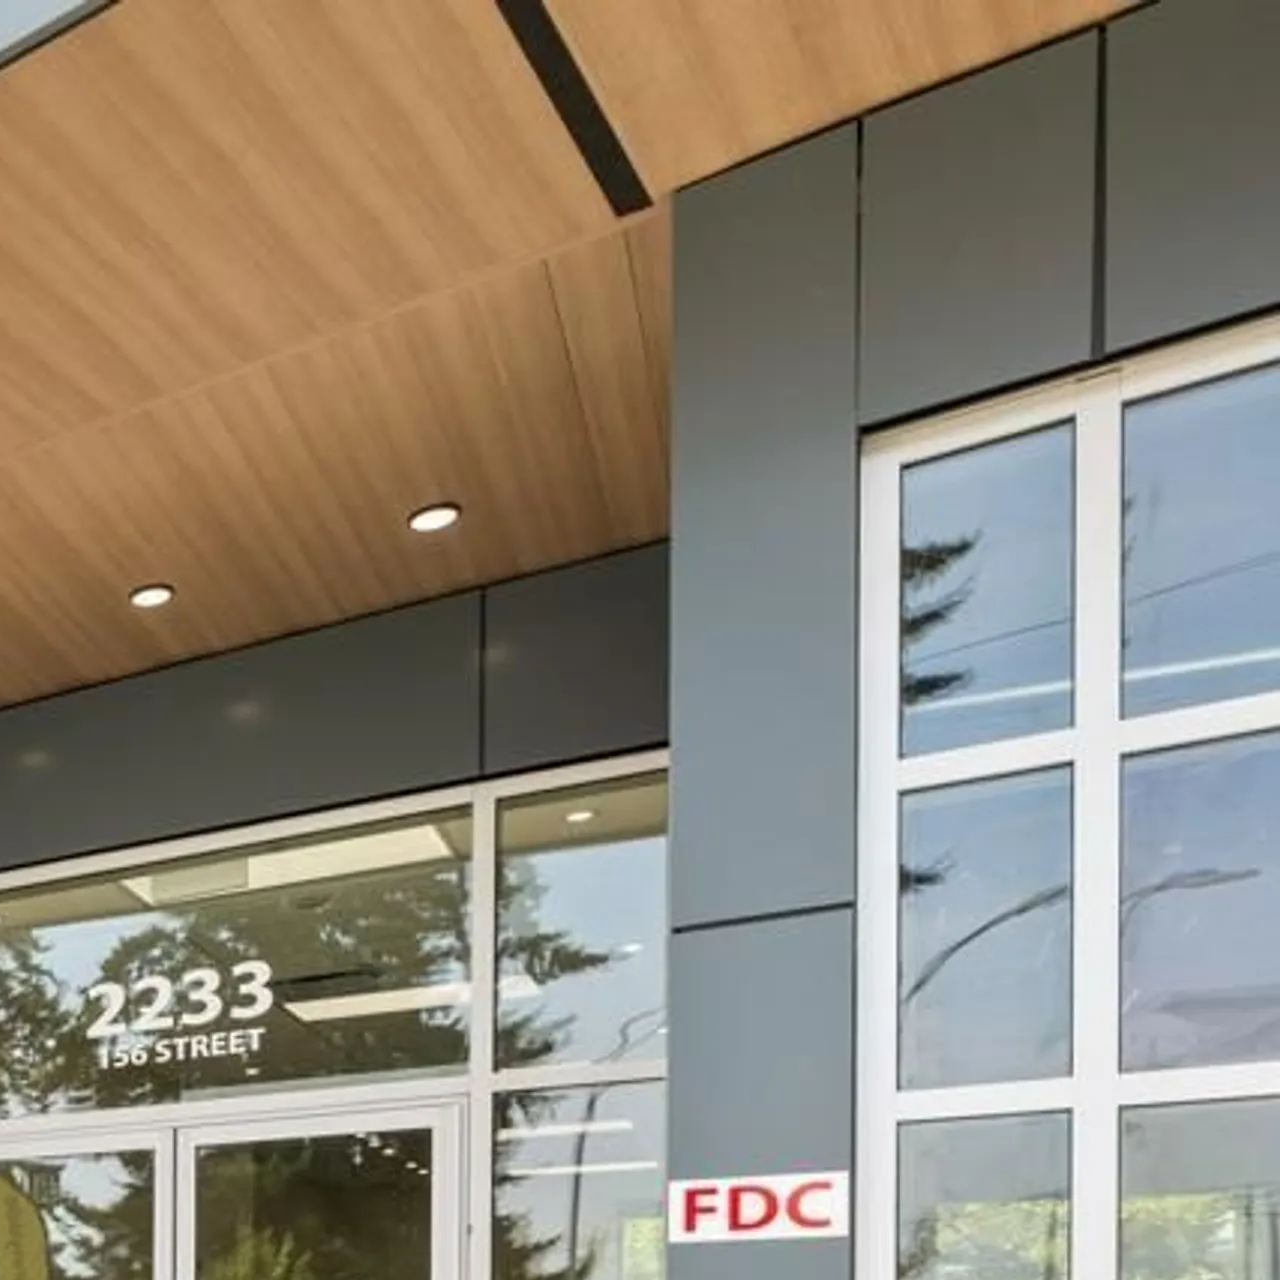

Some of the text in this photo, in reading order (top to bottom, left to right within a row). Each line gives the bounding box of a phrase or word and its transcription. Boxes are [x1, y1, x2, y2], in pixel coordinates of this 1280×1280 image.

[86, 960, 273, 1040] 2233
[98, 1028, 267, 1070] 156 STREET
[685, 1181, 833, 1233] FDC
